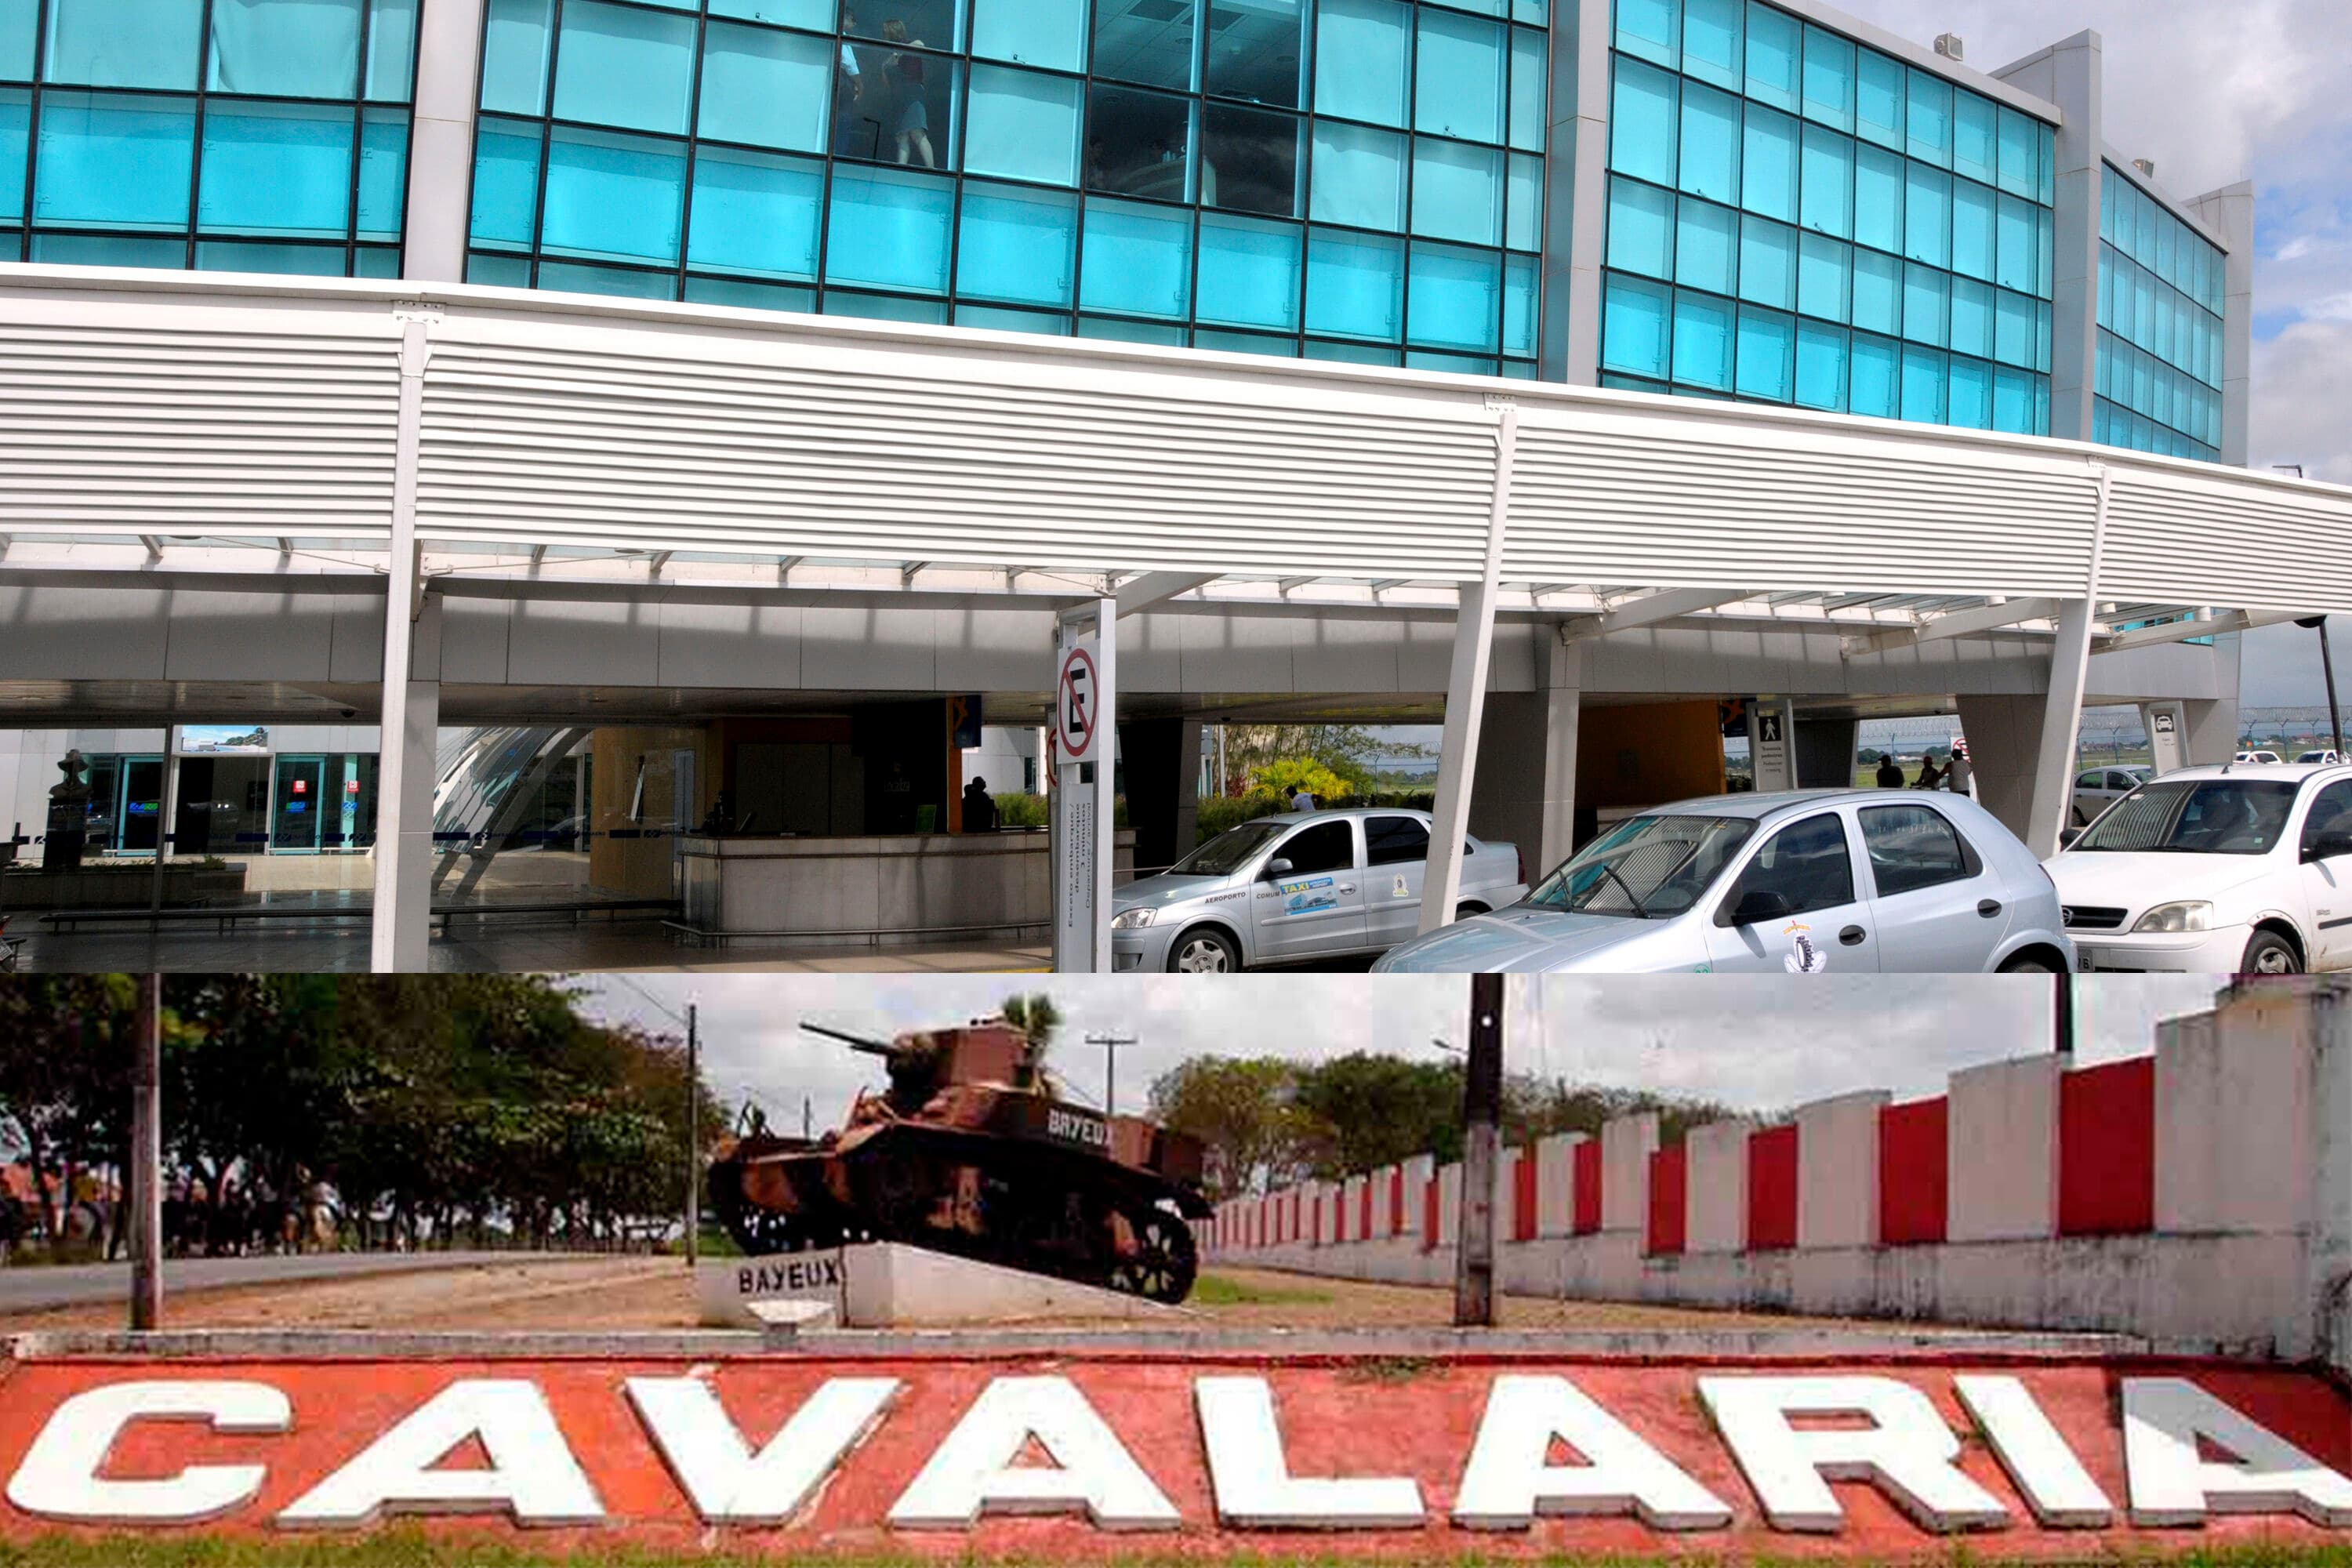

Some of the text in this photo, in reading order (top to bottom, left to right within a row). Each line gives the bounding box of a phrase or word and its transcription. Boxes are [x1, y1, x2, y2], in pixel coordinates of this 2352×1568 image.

[1069, 668, 1087, 733] E
[1204, 891, 1280, 904] AEROPORTO COMUM
[1283, 881, 1310, 894] TAXI
[739, 1259, 839, 1294] BAYEUX
[4, 1374, 2352, 1530] CAVALARIA
